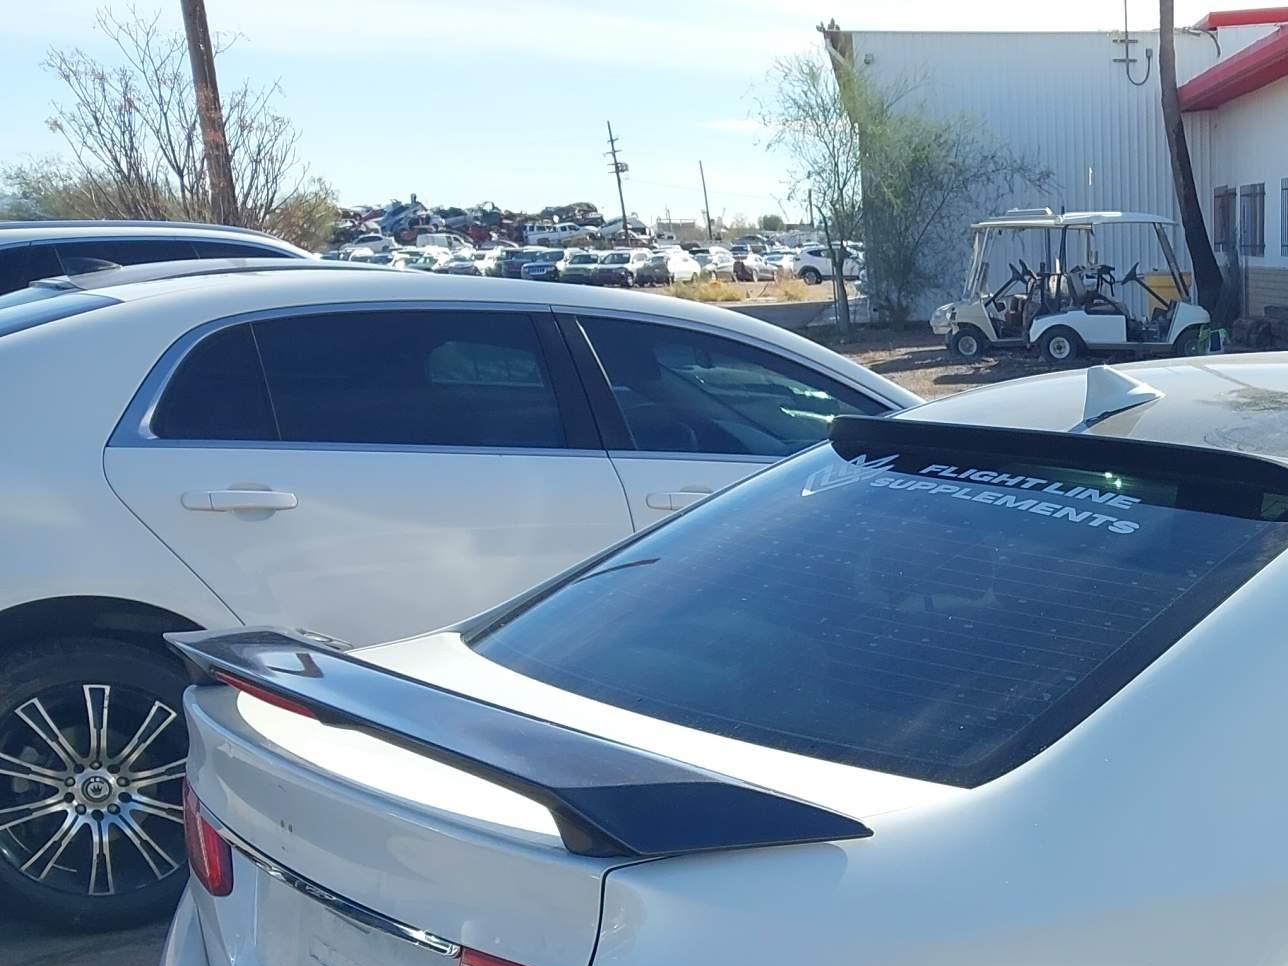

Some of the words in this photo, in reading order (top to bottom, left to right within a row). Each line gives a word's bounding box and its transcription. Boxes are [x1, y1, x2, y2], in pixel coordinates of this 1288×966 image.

[870, 477, 1140, 534] SUPPLEMENTS
[920, 463, 1048, 489] FLIGHT
[1043, 482, 1142, 510] LINE
